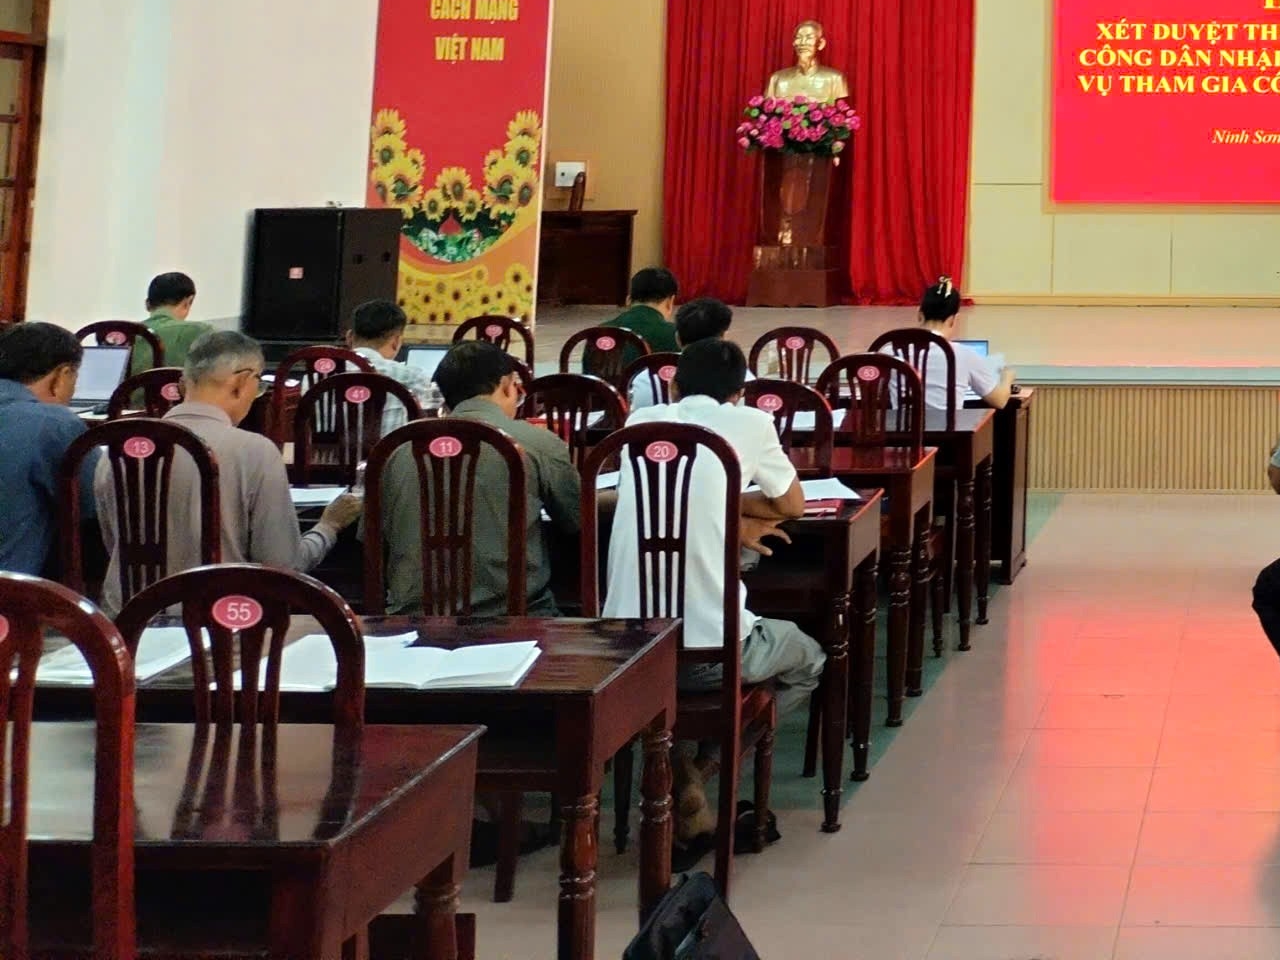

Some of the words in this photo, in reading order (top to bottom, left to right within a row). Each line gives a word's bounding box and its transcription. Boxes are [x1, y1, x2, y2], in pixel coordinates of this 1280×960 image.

[1098, 20, 1146, 40] XÉT
[1154, 22, 1238, 44] DUYỆT
[1080, 46, 1152, 66] CÔNG
[1160, 46, 1211, 66] DÂN
[1079, 76, 1112, 96] VỤ
[1120, 76, 1194, 92] THAM
[1202, 76, 1247, 92] GIA
[1213, 131, 1248, 143] Ninh
[351, 388, 365, 398] 41
[763, 398, 776, 407] 44
[133, 441, 148, 453] 13
[440, 441, 452, 453] 11
[653, 445, 669, 458] 20
[227, 602, 251, 621] 55
